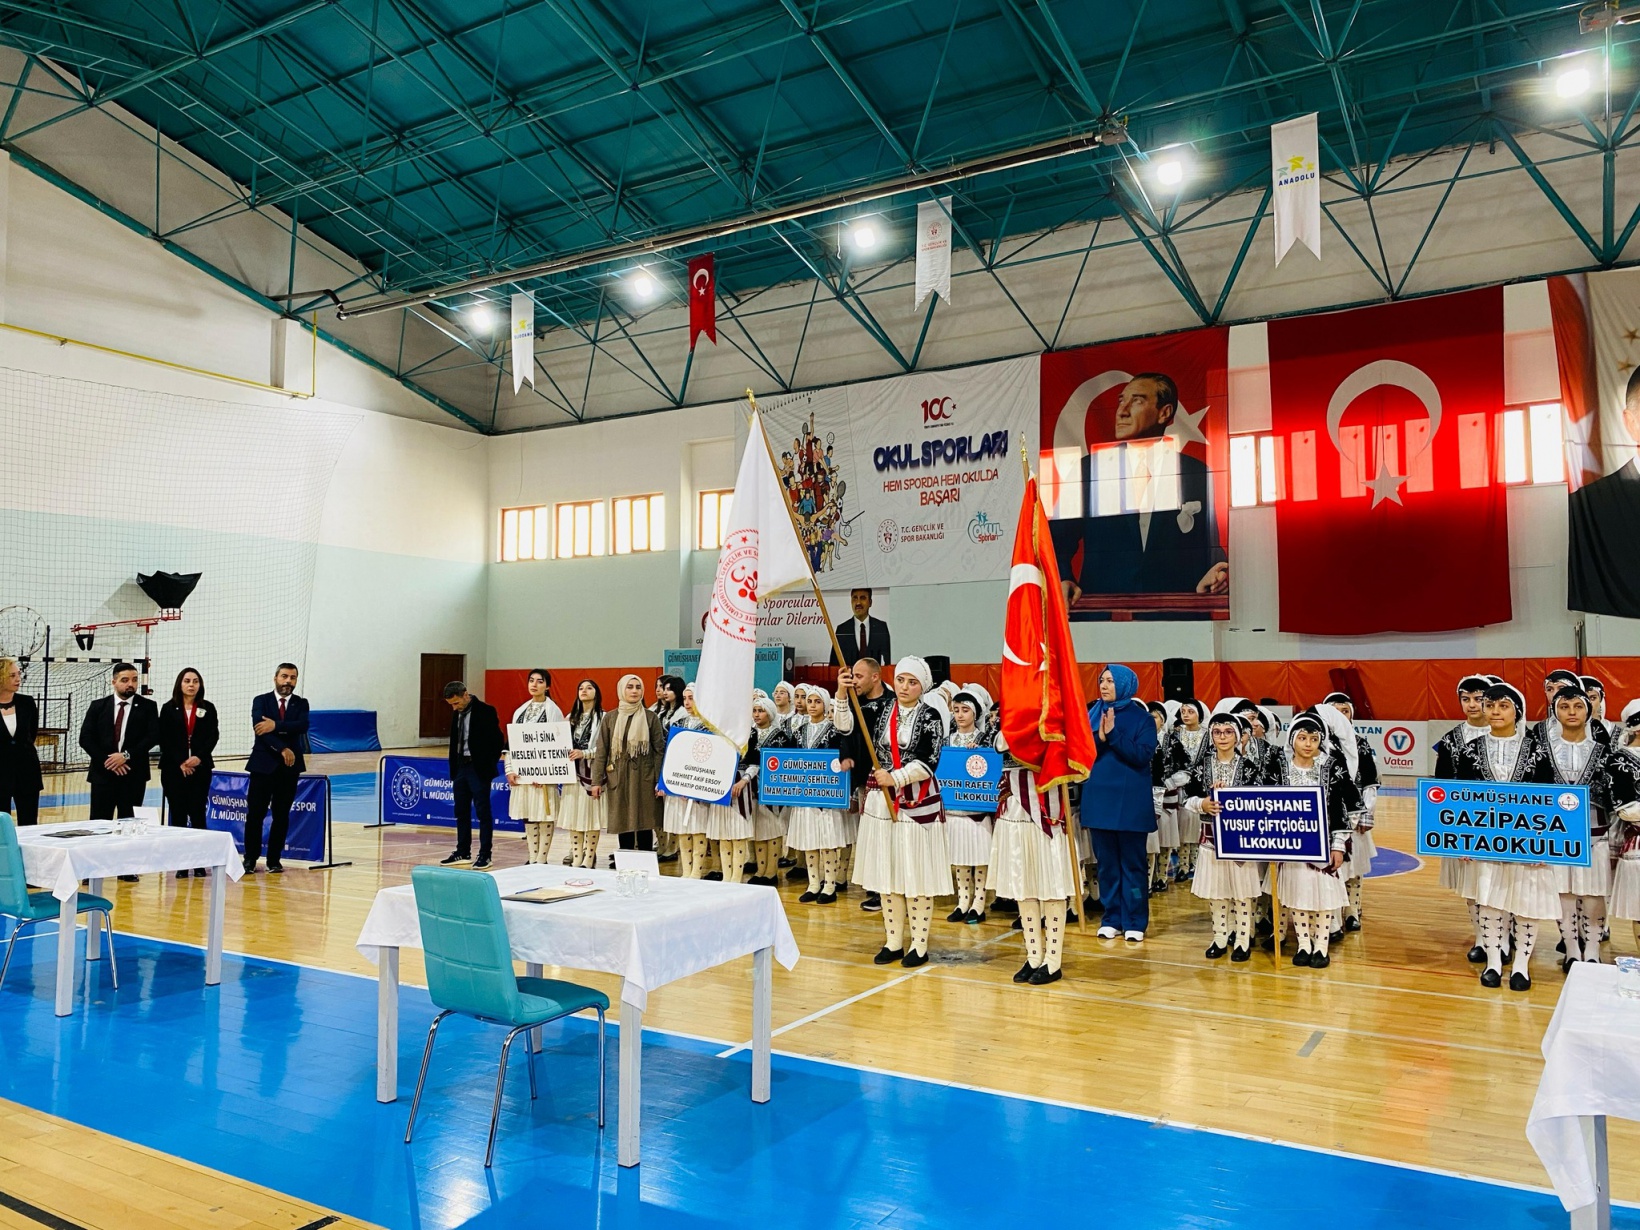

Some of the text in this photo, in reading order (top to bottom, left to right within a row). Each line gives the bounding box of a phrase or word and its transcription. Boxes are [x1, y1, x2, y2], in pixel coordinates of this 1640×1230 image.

[1278, 172, 1315, 187] ANADOLU
[873, 429, 1009, 472] OKUL SPORLARI
[883, 468, 999, 492] HEM SPORDA HEM OKULDA
[920, 487, 960, 507] BAŞARI
[900, 522, 944, 534] T.C. GENÇLİK VE
[972, 523, 1004, 538] OKUL
[900, 532, 945, 543] SPOR BAKANLIĞI
[786, 611, 826, 626] Dilerim
[522, 731, 555, 743] İBN-İ SİNA
[1391, 735, 1407, 750] V
[511, 748, 537, 760] MESLEKİ
[538, 750, 547, 759] VE
[782, 758, 827, 773] GÜMÜŞHANE
[1384, 757, 1414, 766] Vatan
[518, 764, 569, 776] ANADOLU LİSESİ
[684, 764, 716, 776] GÜMÜŞHANE
[672, 772, 693, 780] MEHMET
[705, 777, 721, 786] ERSOY
[770, 774, 840, 786] 15 TEMMUZ ŞEHİTLER
[965, 780, 993, 790] RAFET
[495, 782, 504, 791] VE
[694, 784, 725, 796] ORTAOKULU
[764, 784, 844, 798] İMAM HATİP ORTAOKULU
[422, 790, 428, 799] İL
[955, 790, 1000, 803] İLKOKULU
[1450, 788, 1554, 806] GÜMÜŞHANE
[295, 802, 317, 812] SPOR
[1225, 797, 1312, 814] GÜMÜŞHANE
[210, 808, 217, 819] İL
[1222, 816, 1318, 834] YUSUF ÇİFTÇİOĞLU
[1439, 807, 1568, 835] GAZİPAŞA
[1239, 835, 1302, 850] İLKOKULU
[1425, 832, 1582, 858] ORTAOKULU
